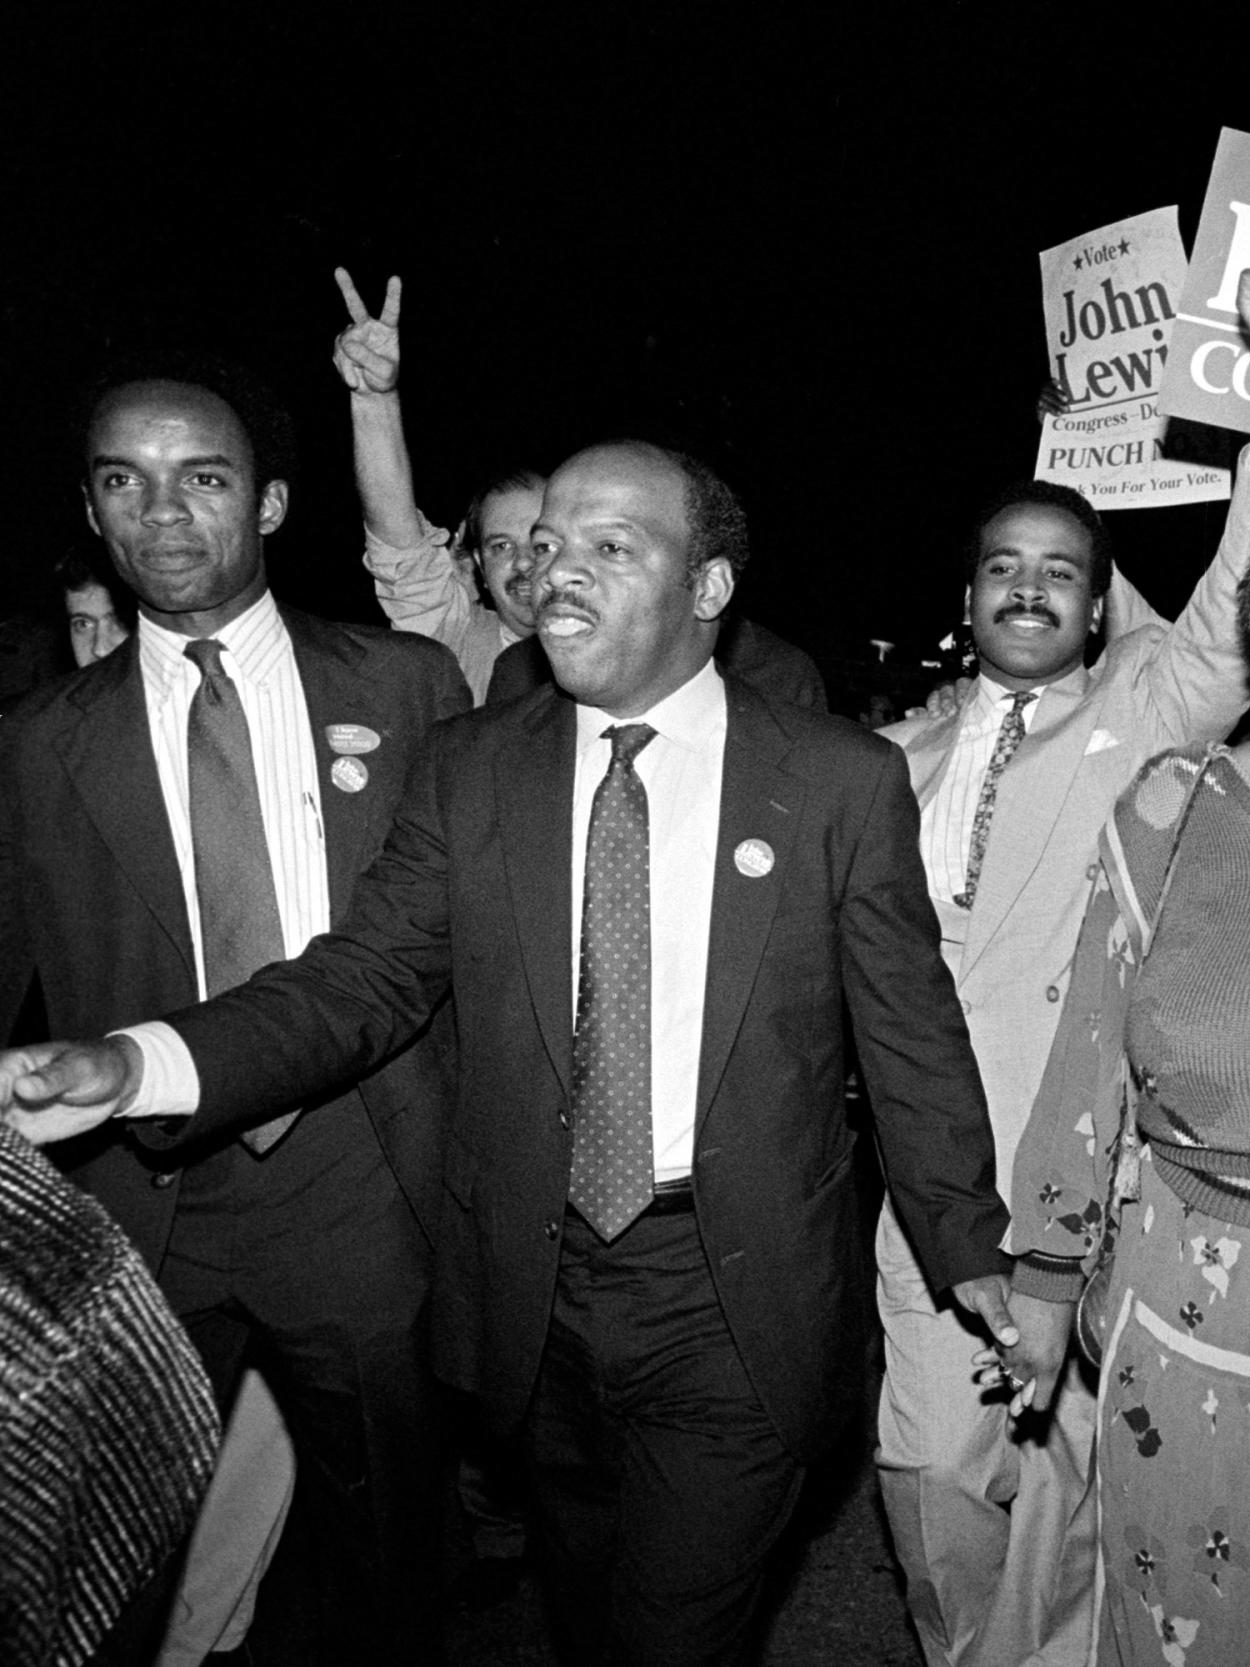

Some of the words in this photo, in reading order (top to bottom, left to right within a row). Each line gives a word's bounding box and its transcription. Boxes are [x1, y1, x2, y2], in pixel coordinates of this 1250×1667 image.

[1083, 243, 1117, 268] Vote
[1059, 277, 1177, 348] John
[1055, 328, 1169, 406] Lewi
[1047, 441, 1144, 470] PUNCH
[1090, 481, 1117, 496] You
[1121, 480, 1145, 494] For
[1149, 477, 1184, 492] Your
[1186, 471, 1223, 486] Vote.
